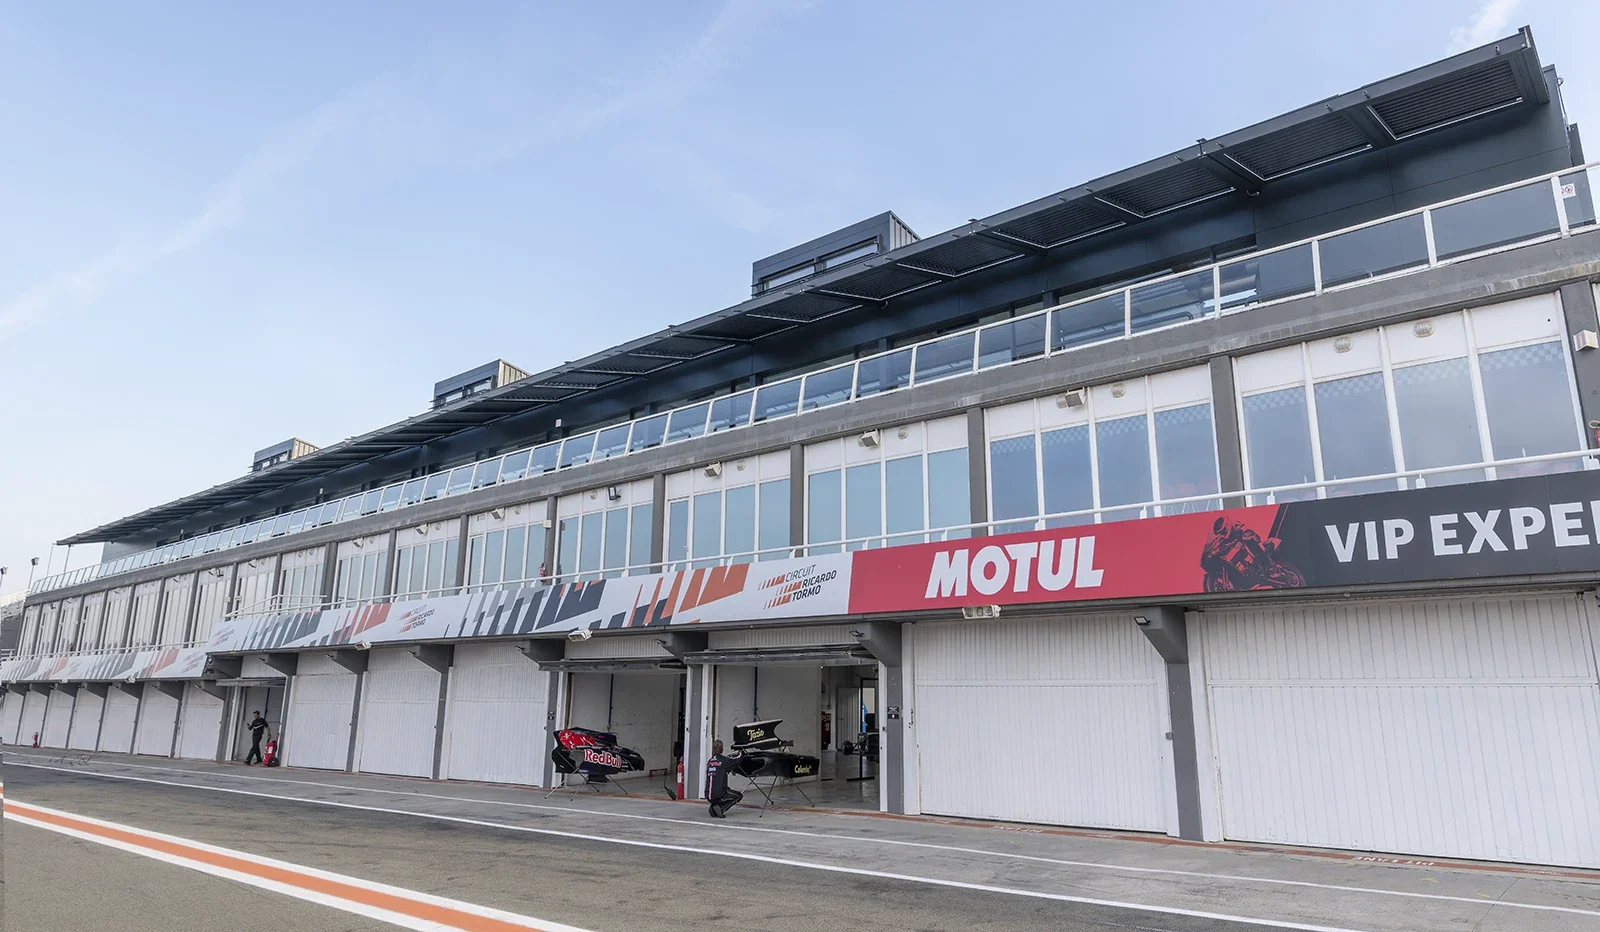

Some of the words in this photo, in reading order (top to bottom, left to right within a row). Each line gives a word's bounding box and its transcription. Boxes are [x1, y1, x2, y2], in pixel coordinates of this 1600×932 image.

[1324, 518, 1415, 563] VIP
[1429, 499, 1600, 556] EXPE
[785, 564, 817, 582] CIRCUIT
[924, 535, 1105, 599] MOTUL
[802, 570, 837, 588] RICARDO
[792, 585, 821, 601] TORMO
[584, 748, 605, 764] Red
[605, 751, 622, 768] Bull
